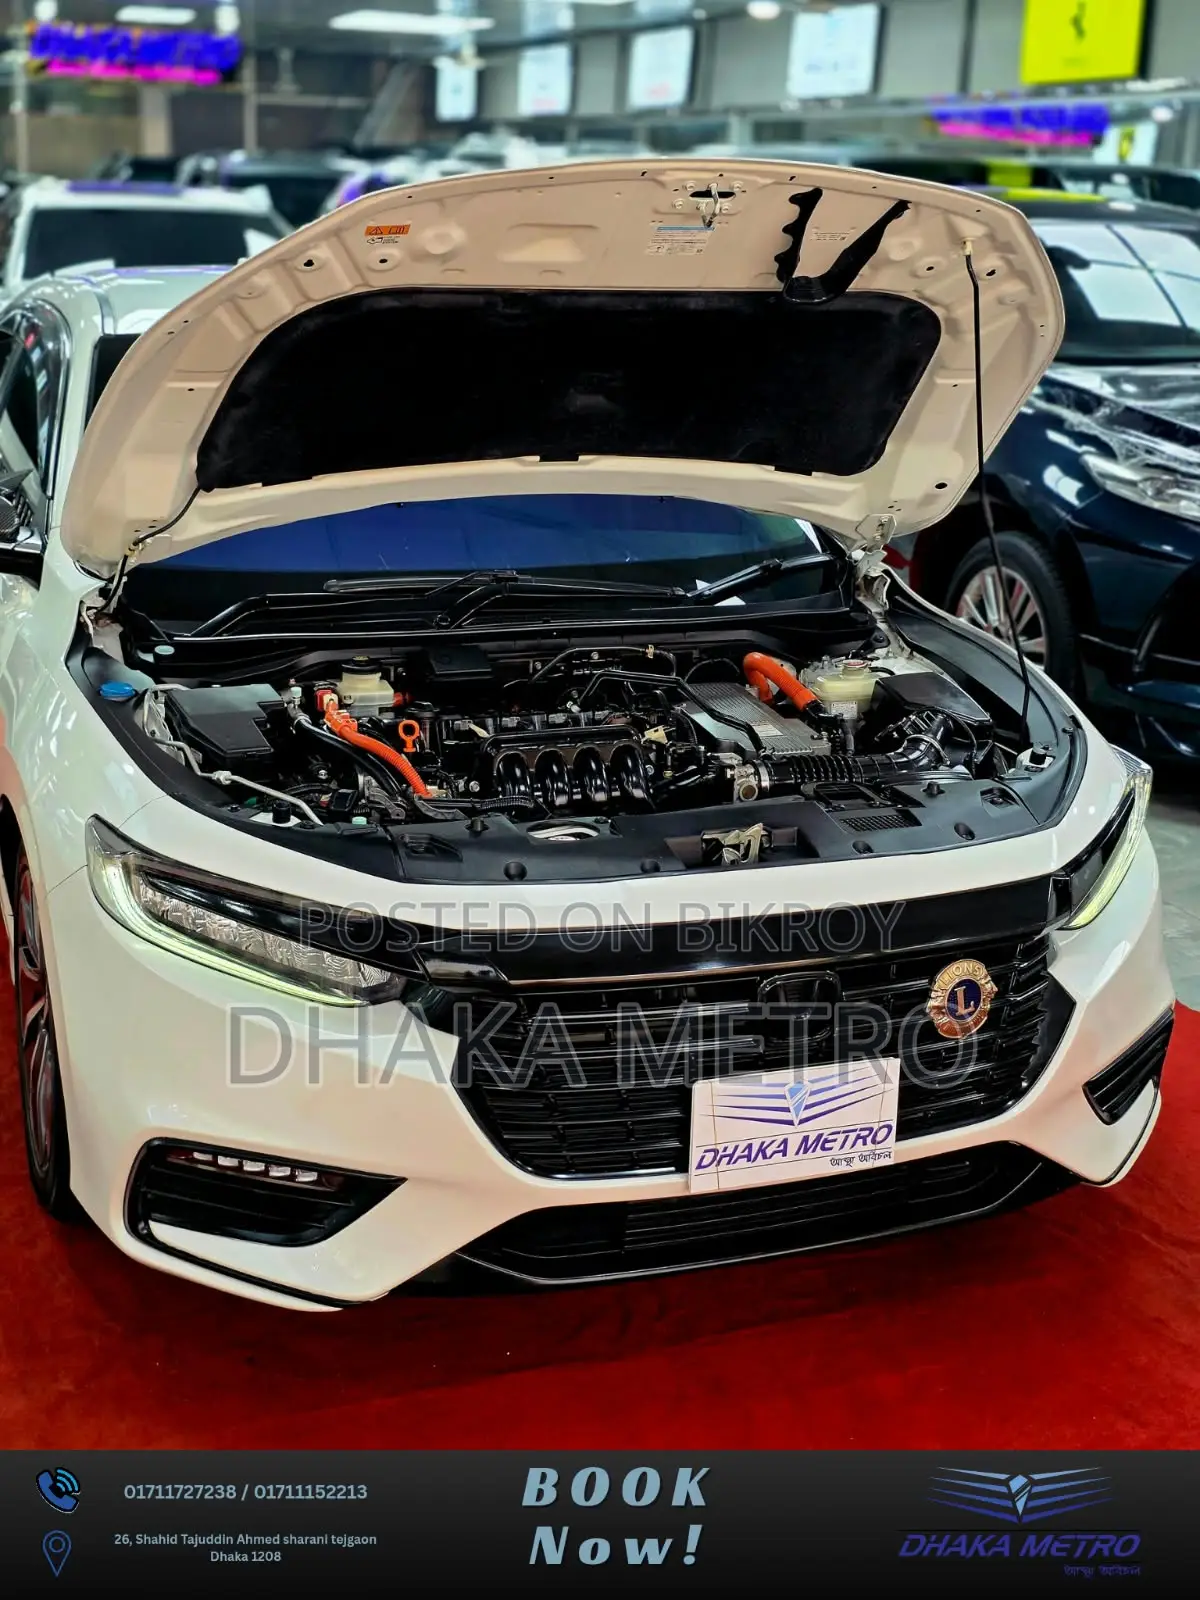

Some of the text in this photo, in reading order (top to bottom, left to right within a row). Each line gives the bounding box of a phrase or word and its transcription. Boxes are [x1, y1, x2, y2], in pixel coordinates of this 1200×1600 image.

[938, 963, 982, 985] LIONS
[695, 1123, 894, 1170] DHAKA METRO
